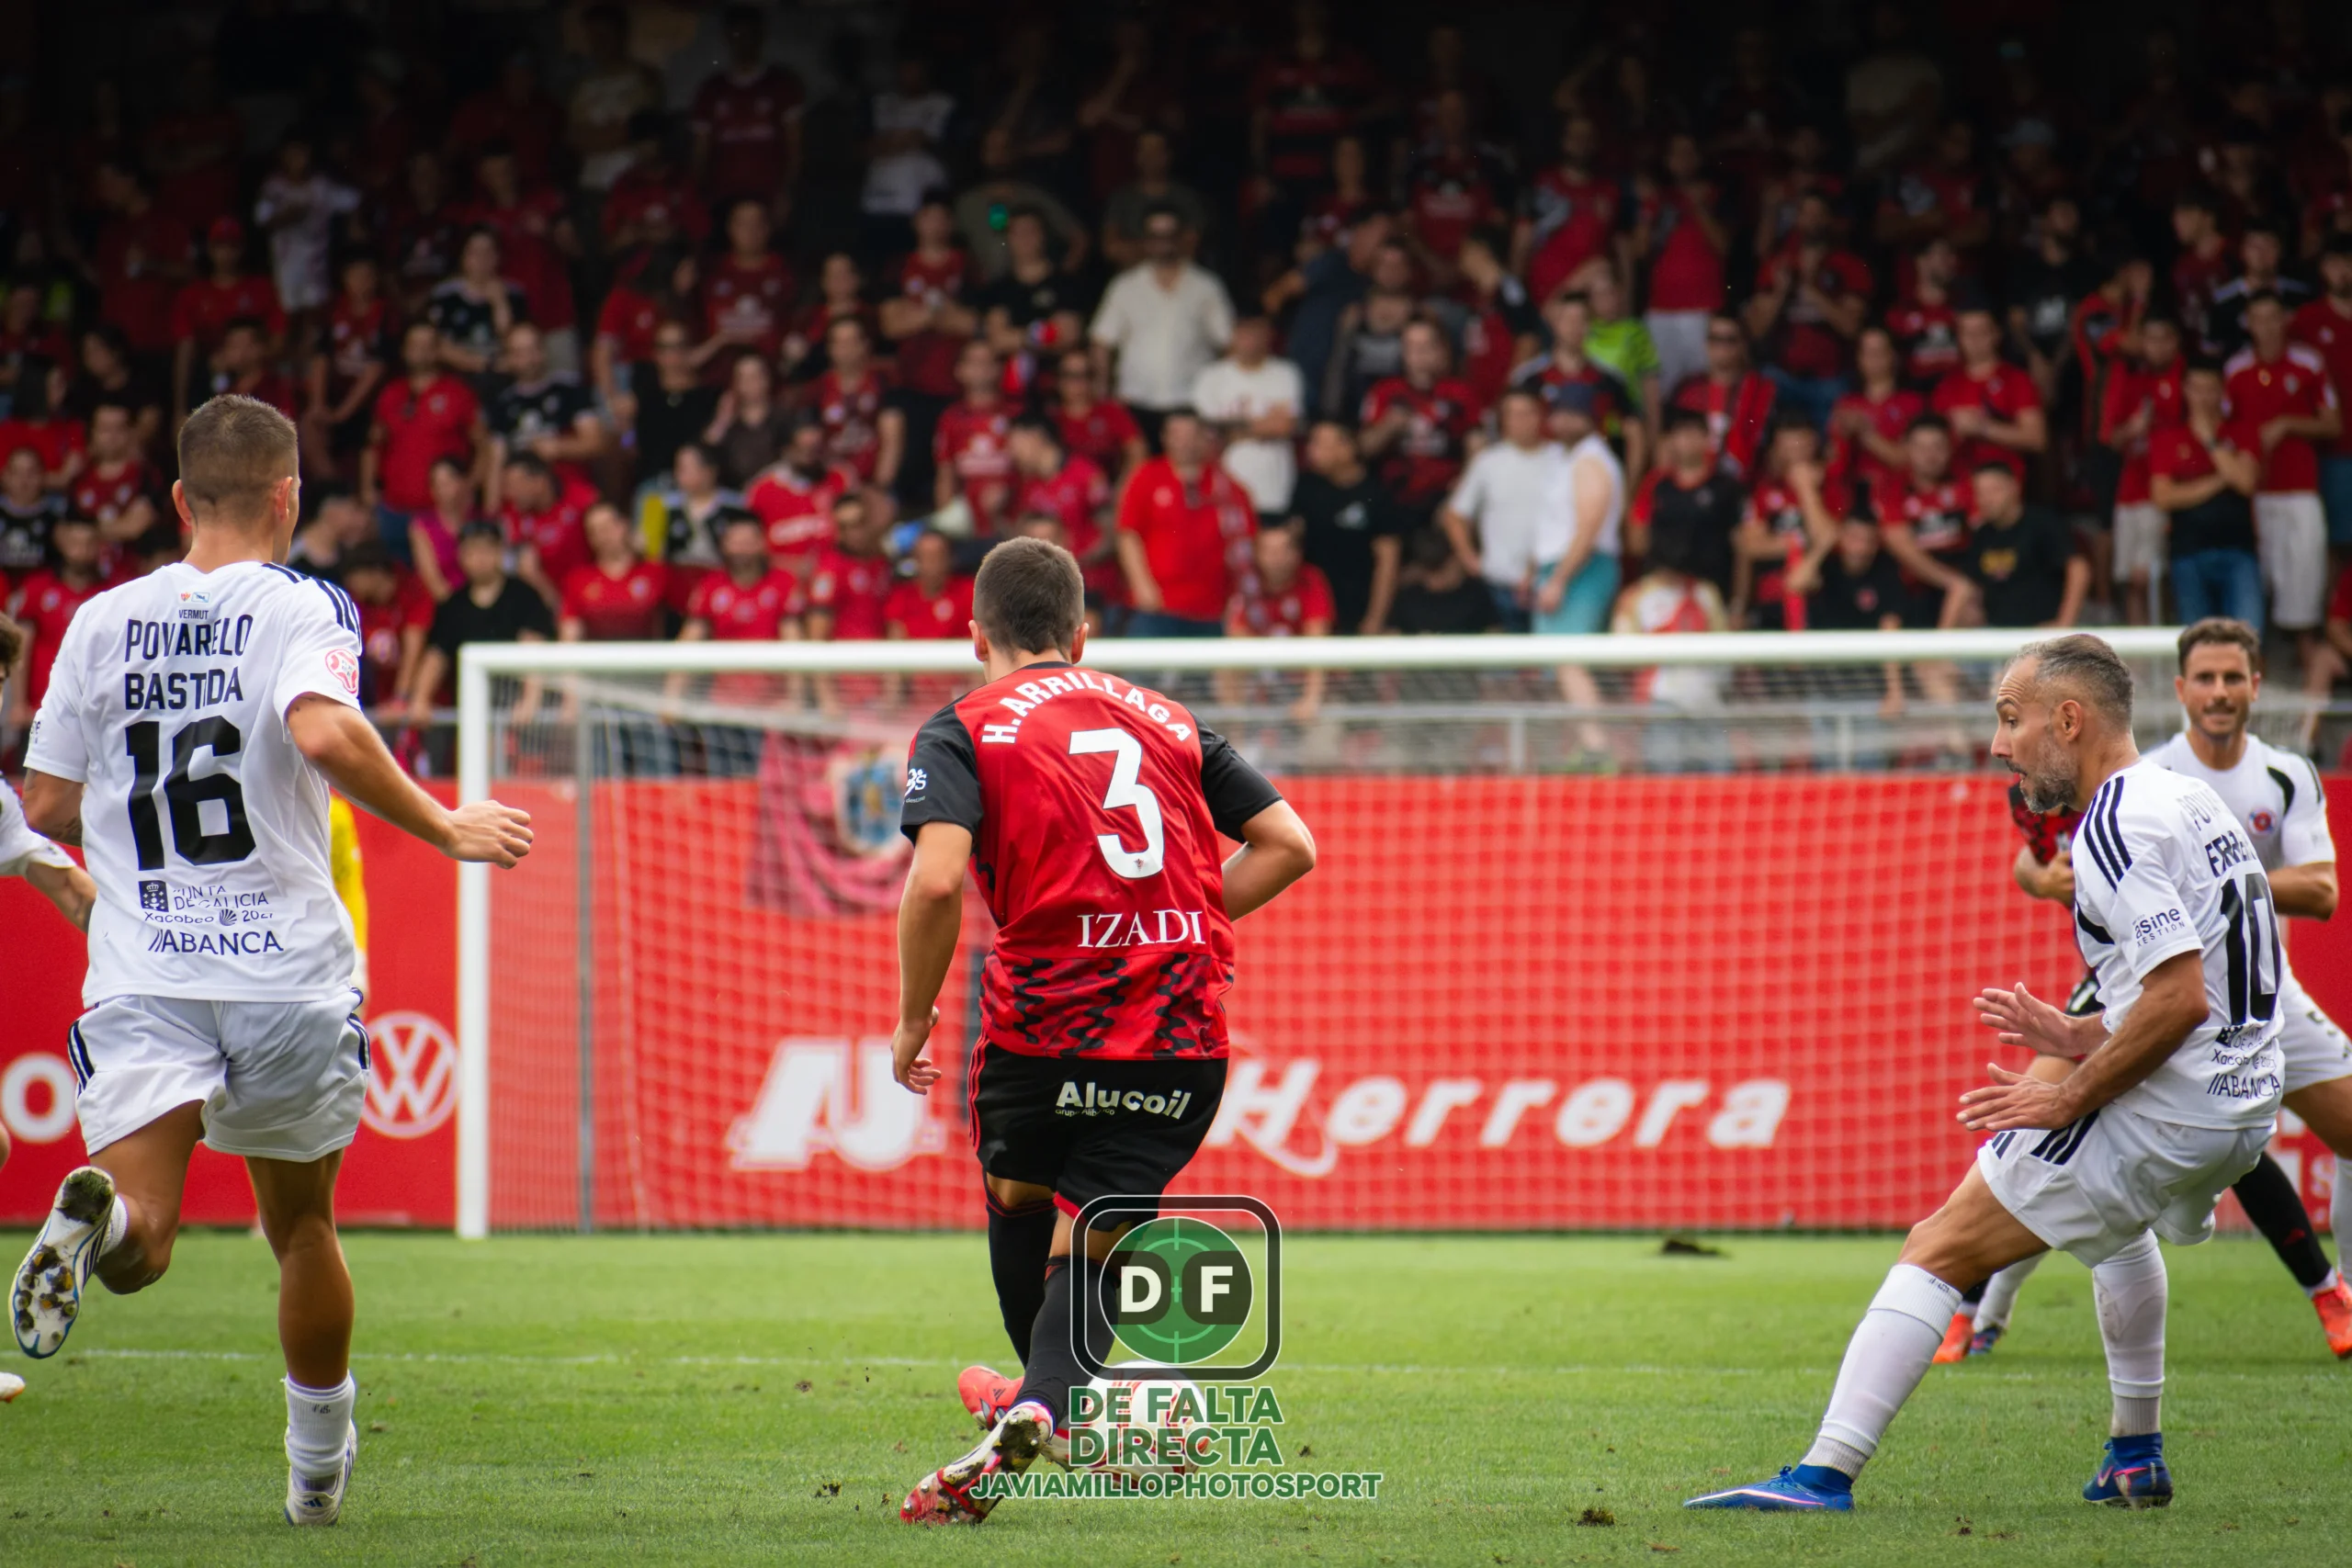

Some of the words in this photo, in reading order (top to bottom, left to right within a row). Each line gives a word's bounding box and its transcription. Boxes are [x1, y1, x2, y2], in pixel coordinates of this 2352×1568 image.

[178, 609, 209, 620] VERMUT
[124, 614, 254, 663] POVARELO
[124, 666, 244, 711] BASTIDA
[981, 671, 1192, 744] H.ARRILLAGA
[125, 715, 257, 872] 16
[1069, 728, 1164, 879] 3
[173, 885, 227, 900] UNTA
[144, 911, 215, 924] Xacobeo
[1076, 908, 1207, 949] IZADI
[156, 929, 285, 956] ABANCA
[2221, 872, 2281, 1025] 10
[1056, 1081, 1193, 1120] Alucoil
[1201, 1057, 1792, 1172] Herrera
